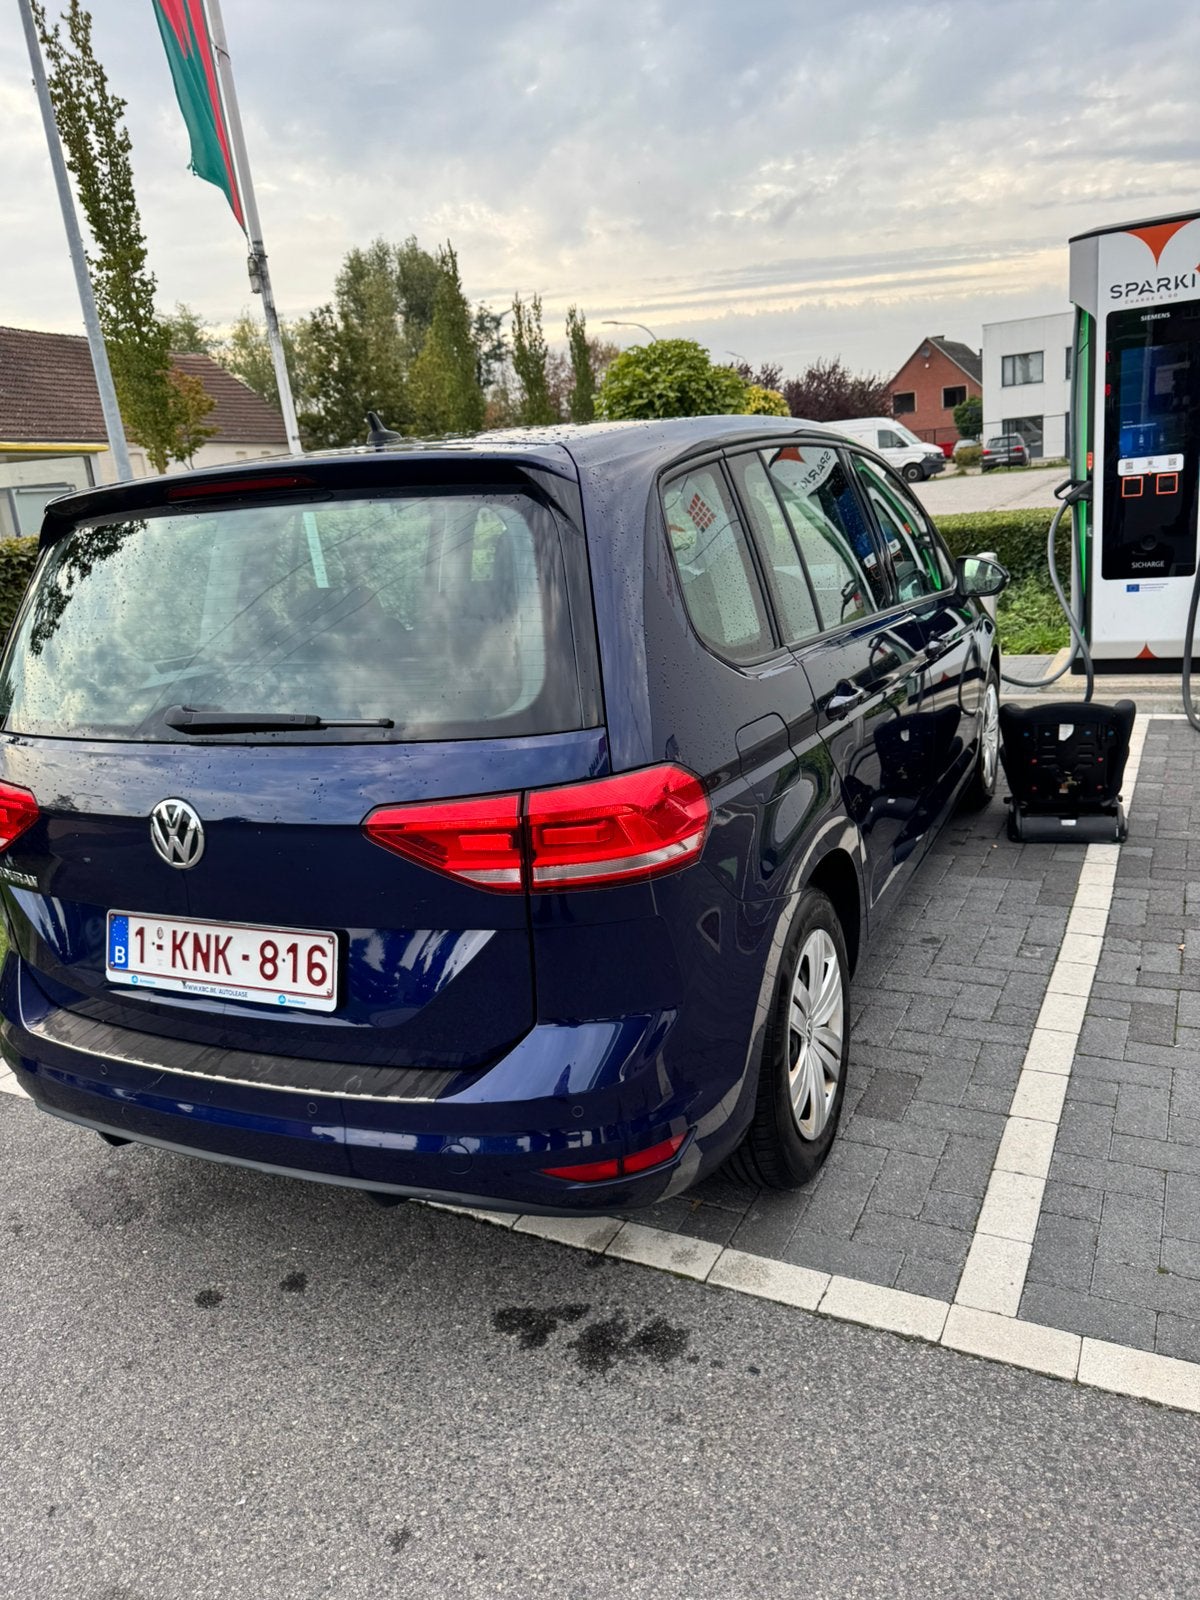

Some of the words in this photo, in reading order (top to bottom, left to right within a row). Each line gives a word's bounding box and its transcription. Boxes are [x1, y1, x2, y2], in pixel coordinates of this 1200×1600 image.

[1110, 273, 1196, 299] SPARKI
[1140, 312, 1171, 321] SIEMENS
[1131, 560, 1165, 569] SICHARGE
[114, 946, 126, 964] B
[135, 926, 329, 987] 1-KNK-816
